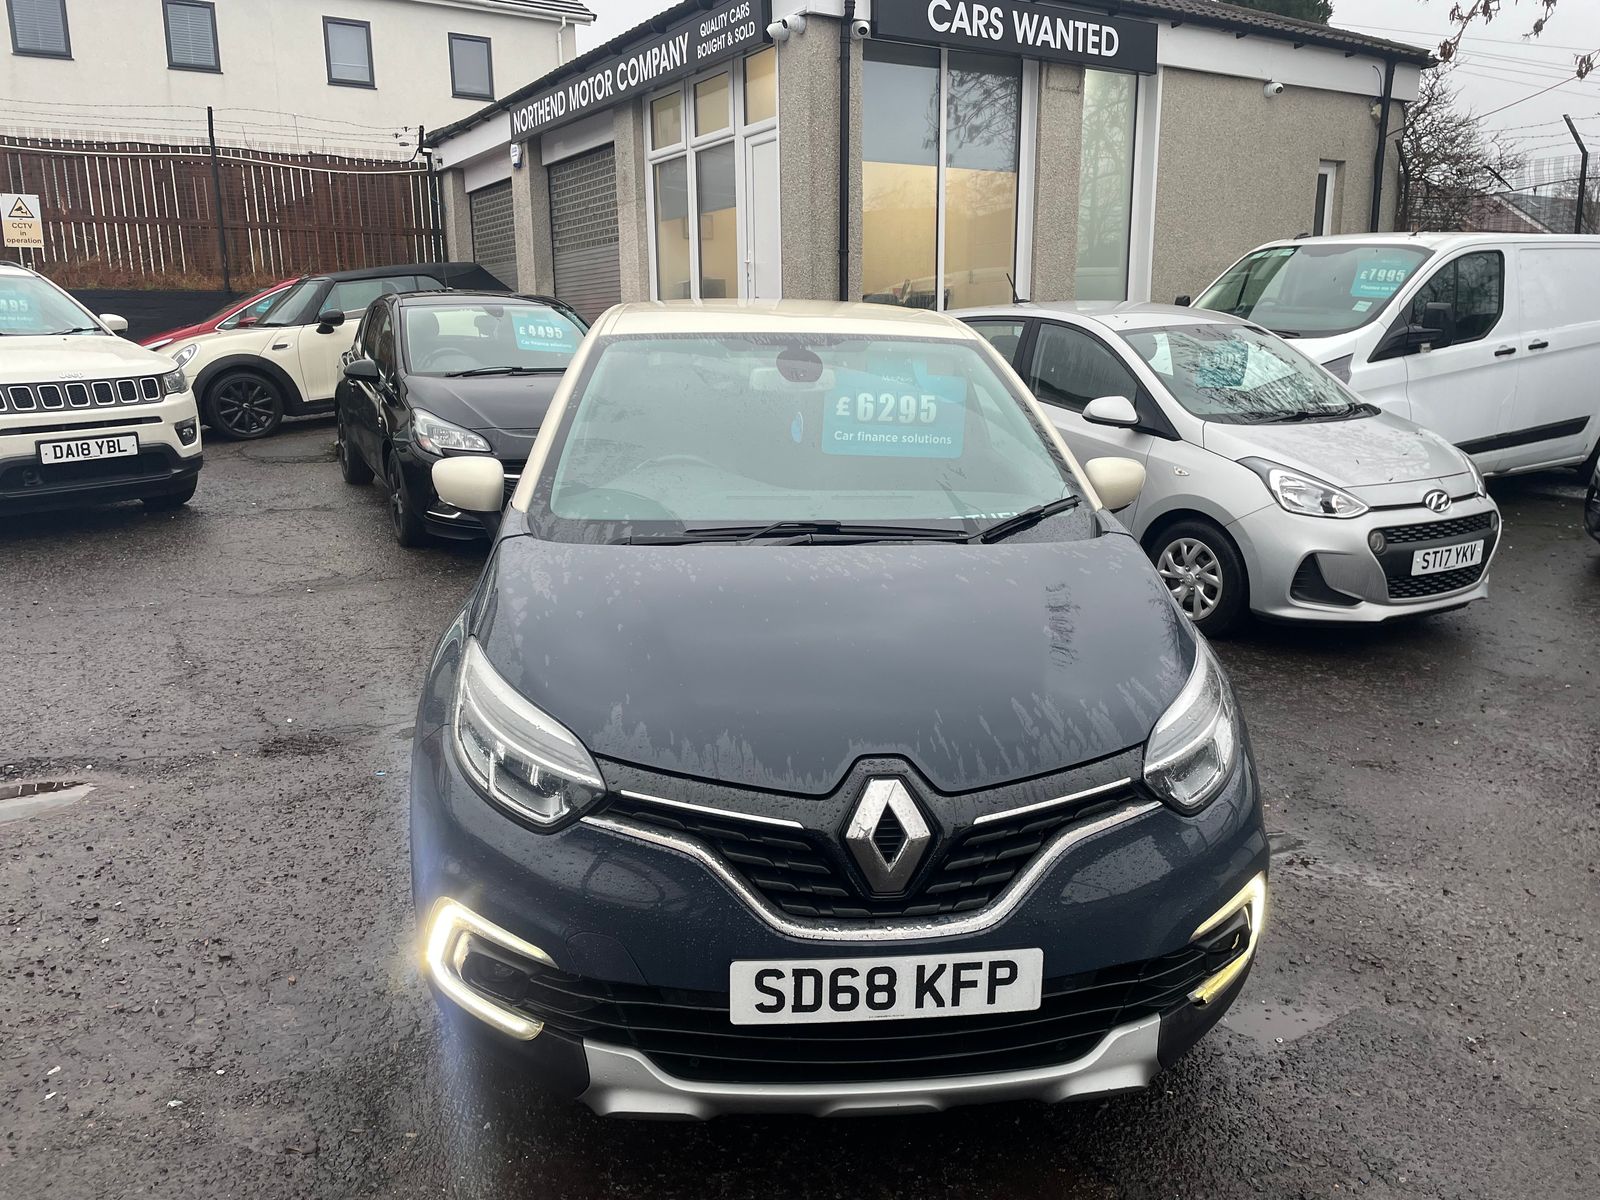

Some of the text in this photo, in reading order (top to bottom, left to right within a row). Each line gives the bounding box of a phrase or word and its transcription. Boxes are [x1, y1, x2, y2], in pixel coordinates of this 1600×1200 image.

[700, 2, 750, 37] QUALITY CARS
[927, 0, 1119, 57] CARS WANTED
[697, 21, 756, 59] BOUGHT & SOLD
[513, 32, 689, 135] NORTHEND MOTOR COMPANY
[835, 392, 938, 424] £6295
[52, 439, 127, 460] DA18 YBL
[834, 430, 952, 445] Car finance solutions
[1421, 543, 1477, 569] ST17 YKV
[754, 959, 1019, 1013] SD68 KFP
